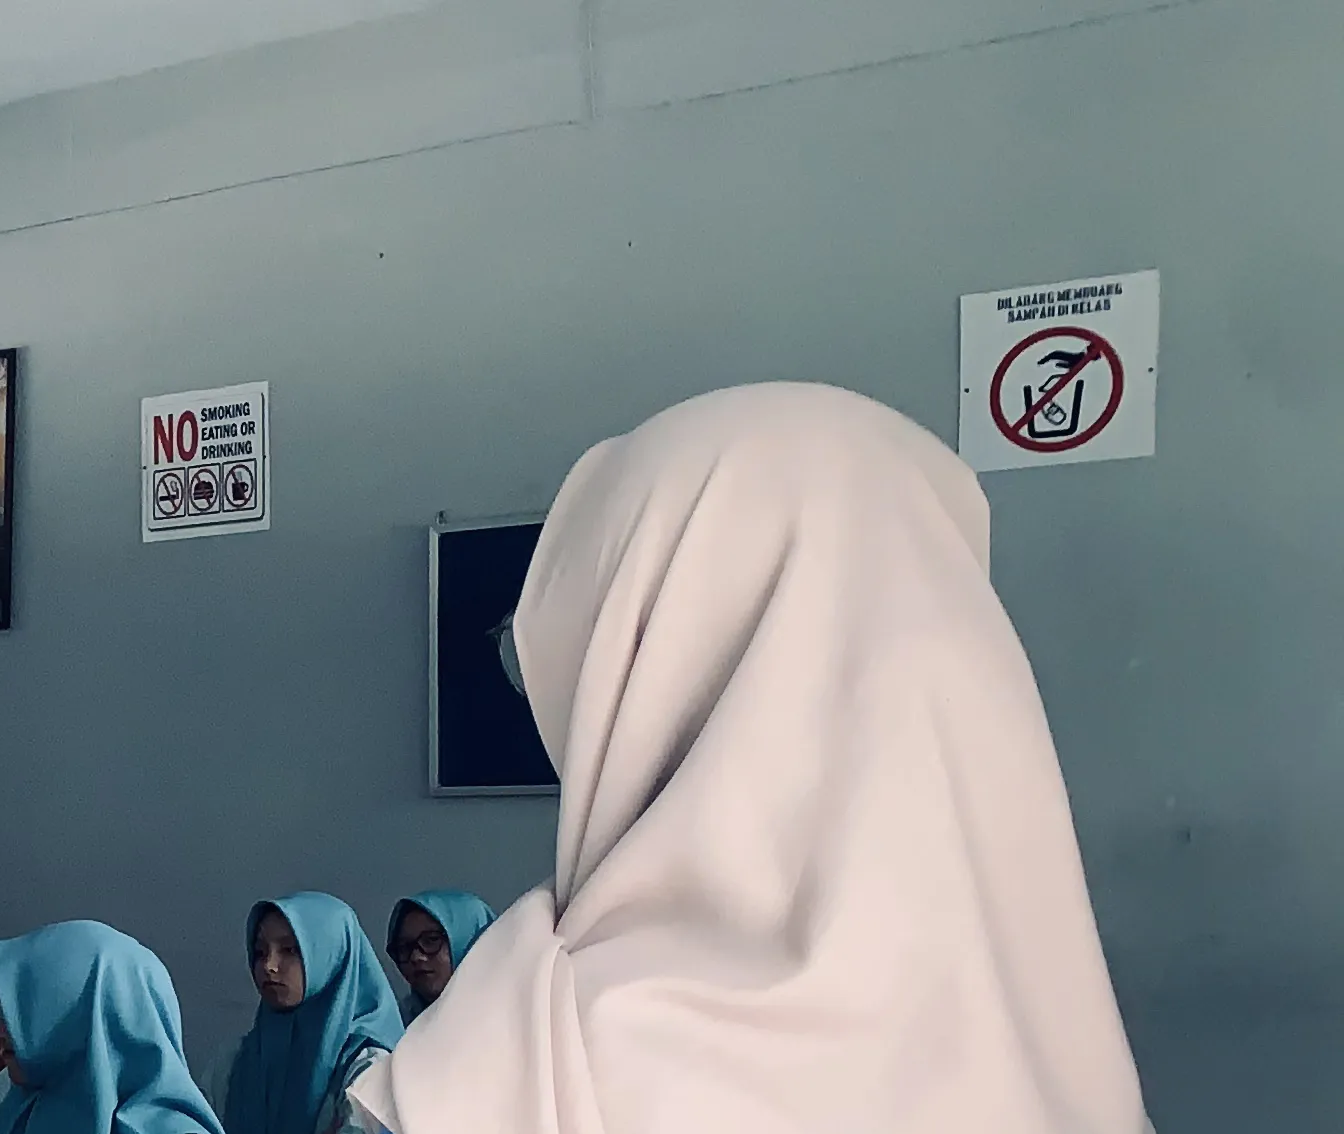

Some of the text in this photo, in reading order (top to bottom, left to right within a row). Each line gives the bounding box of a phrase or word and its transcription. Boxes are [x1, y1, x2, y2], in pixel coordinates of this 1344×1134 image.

[998, 282, 1122, 311] DILARANG MEMBUANG
[1008, 298, 1111, 323] SAMPAH DI KELAS
[201, 401, 251, 422] SMOKING
[153, 410, 199, 465] NO
[201, 421, 256, 441] EATING OR
[201, 440, 253, 460] DRINKING
